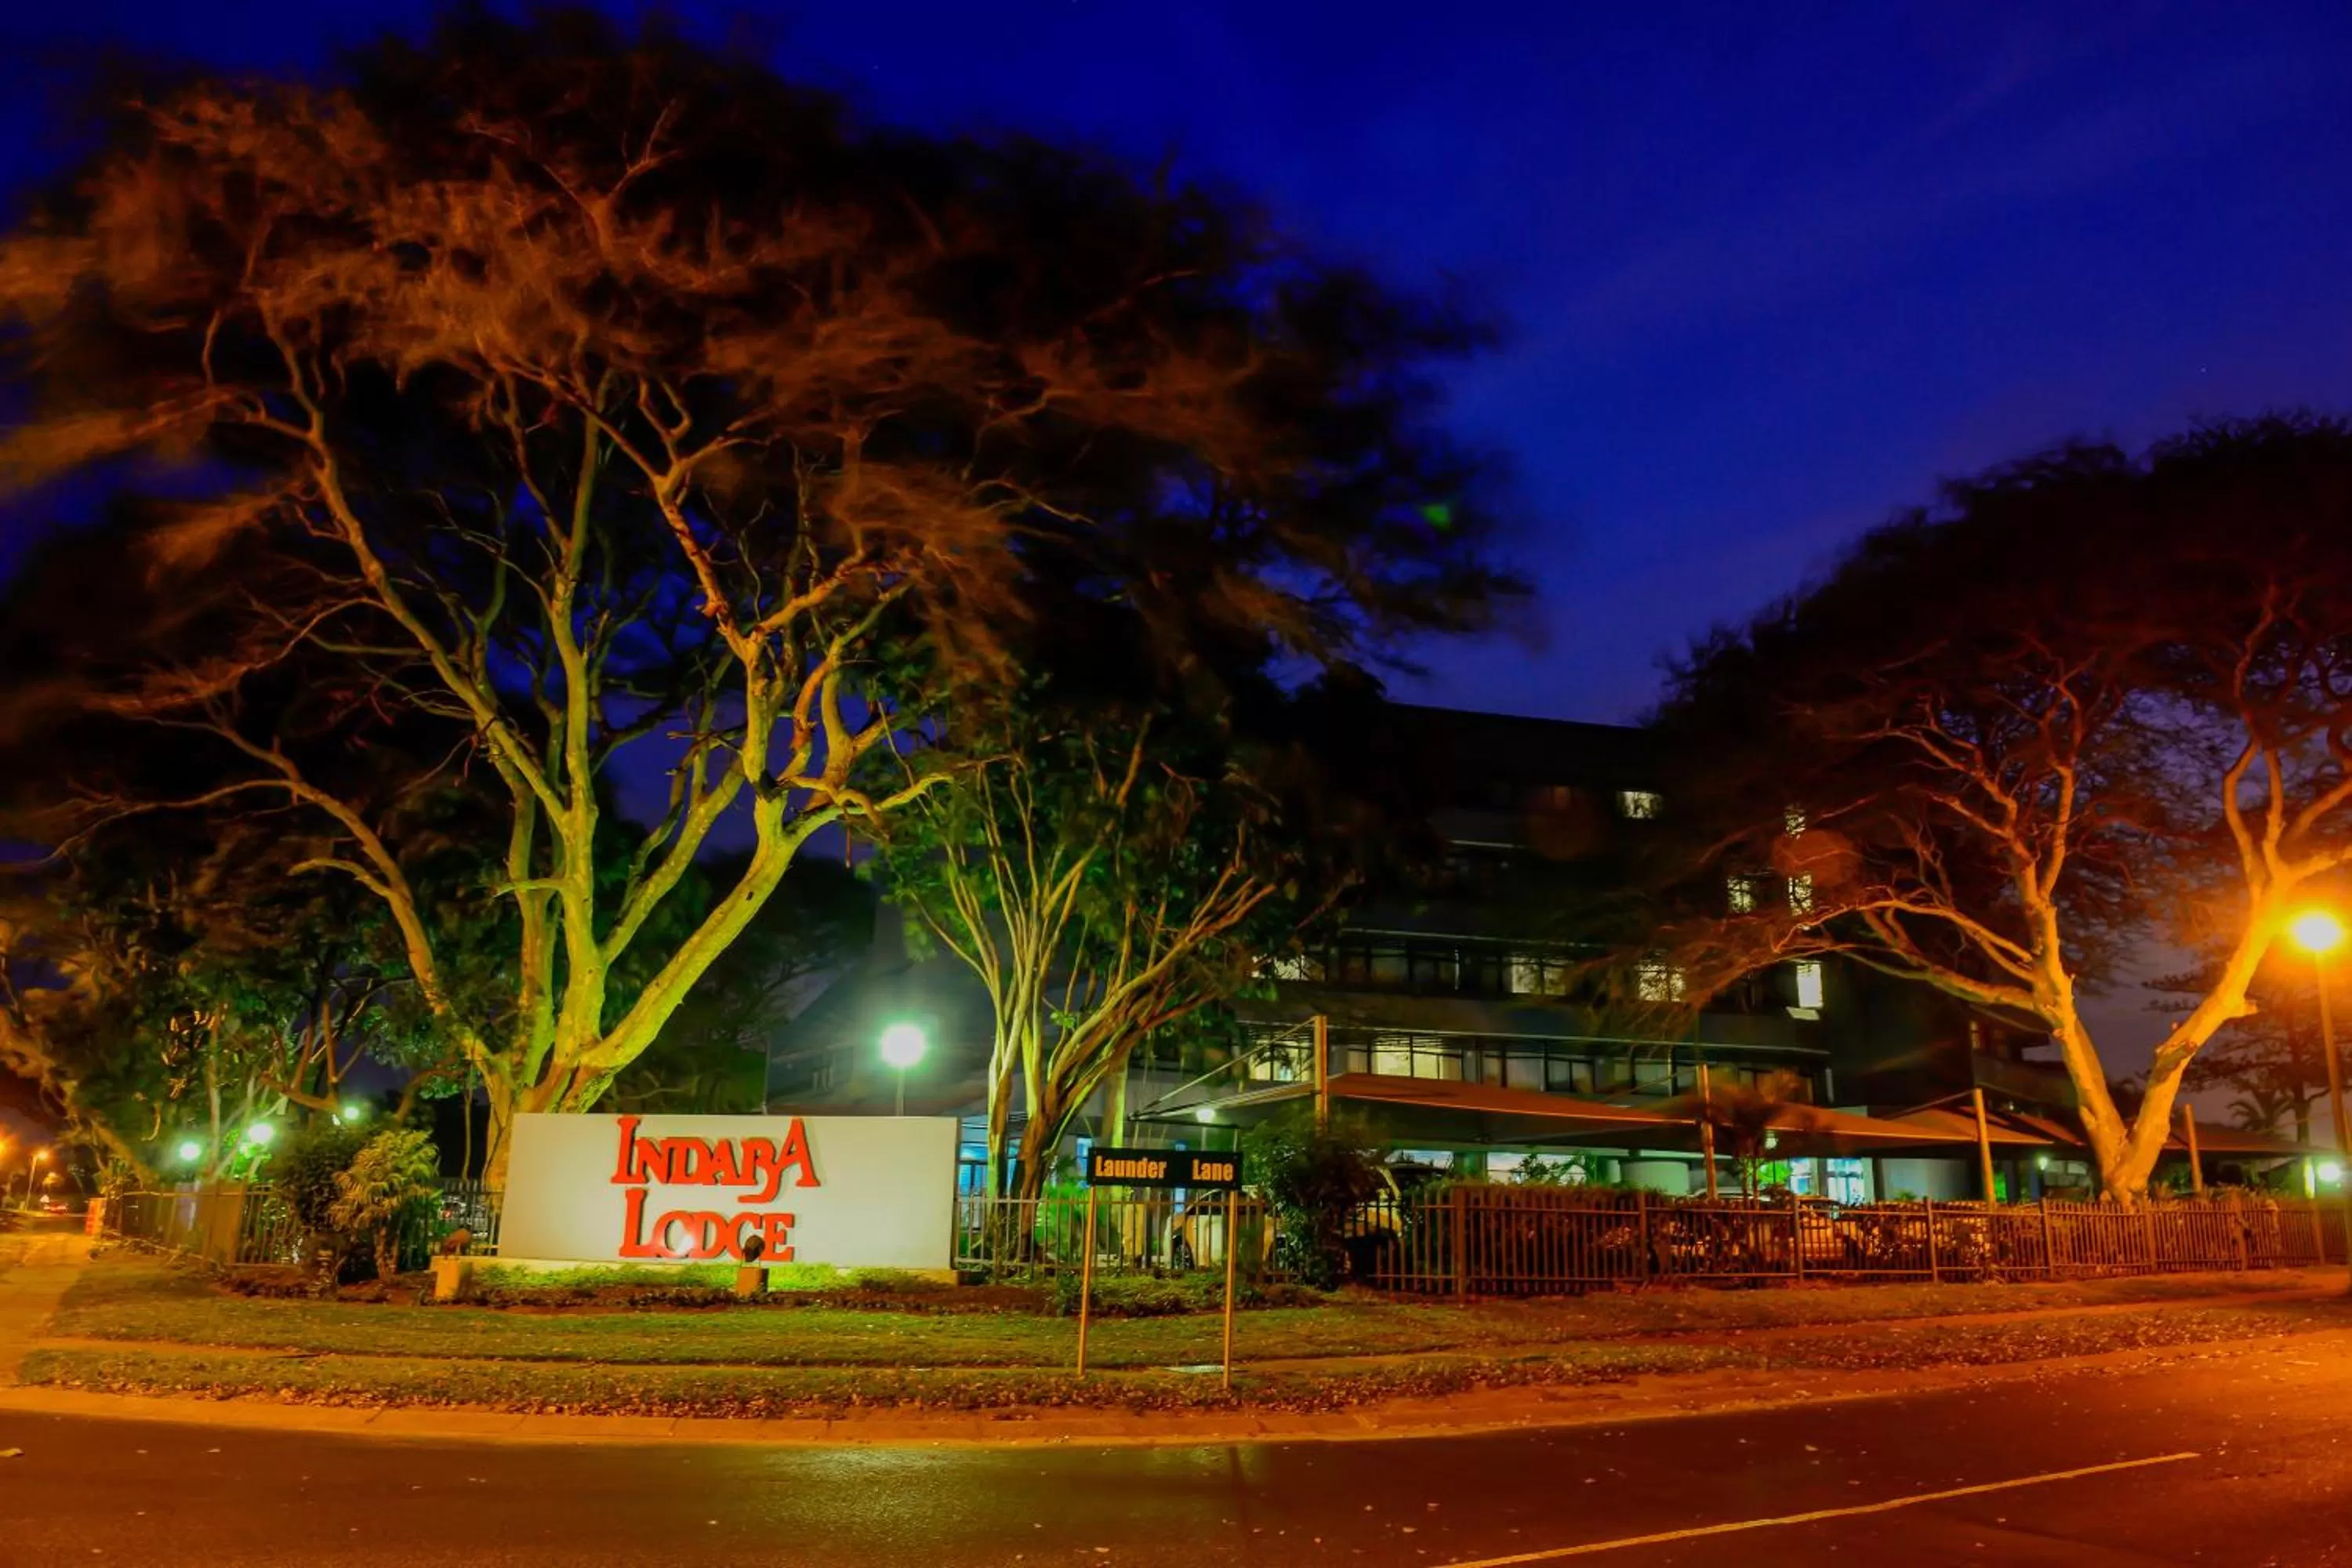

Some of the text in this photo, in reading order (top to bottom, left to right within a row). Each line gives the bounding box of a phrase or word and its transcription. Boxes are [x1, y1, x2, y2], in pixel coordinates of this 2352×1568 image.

[611, 1115, 821, 1203] INDABA
[1095, 1156, 1233, 1181] Launder Lane
